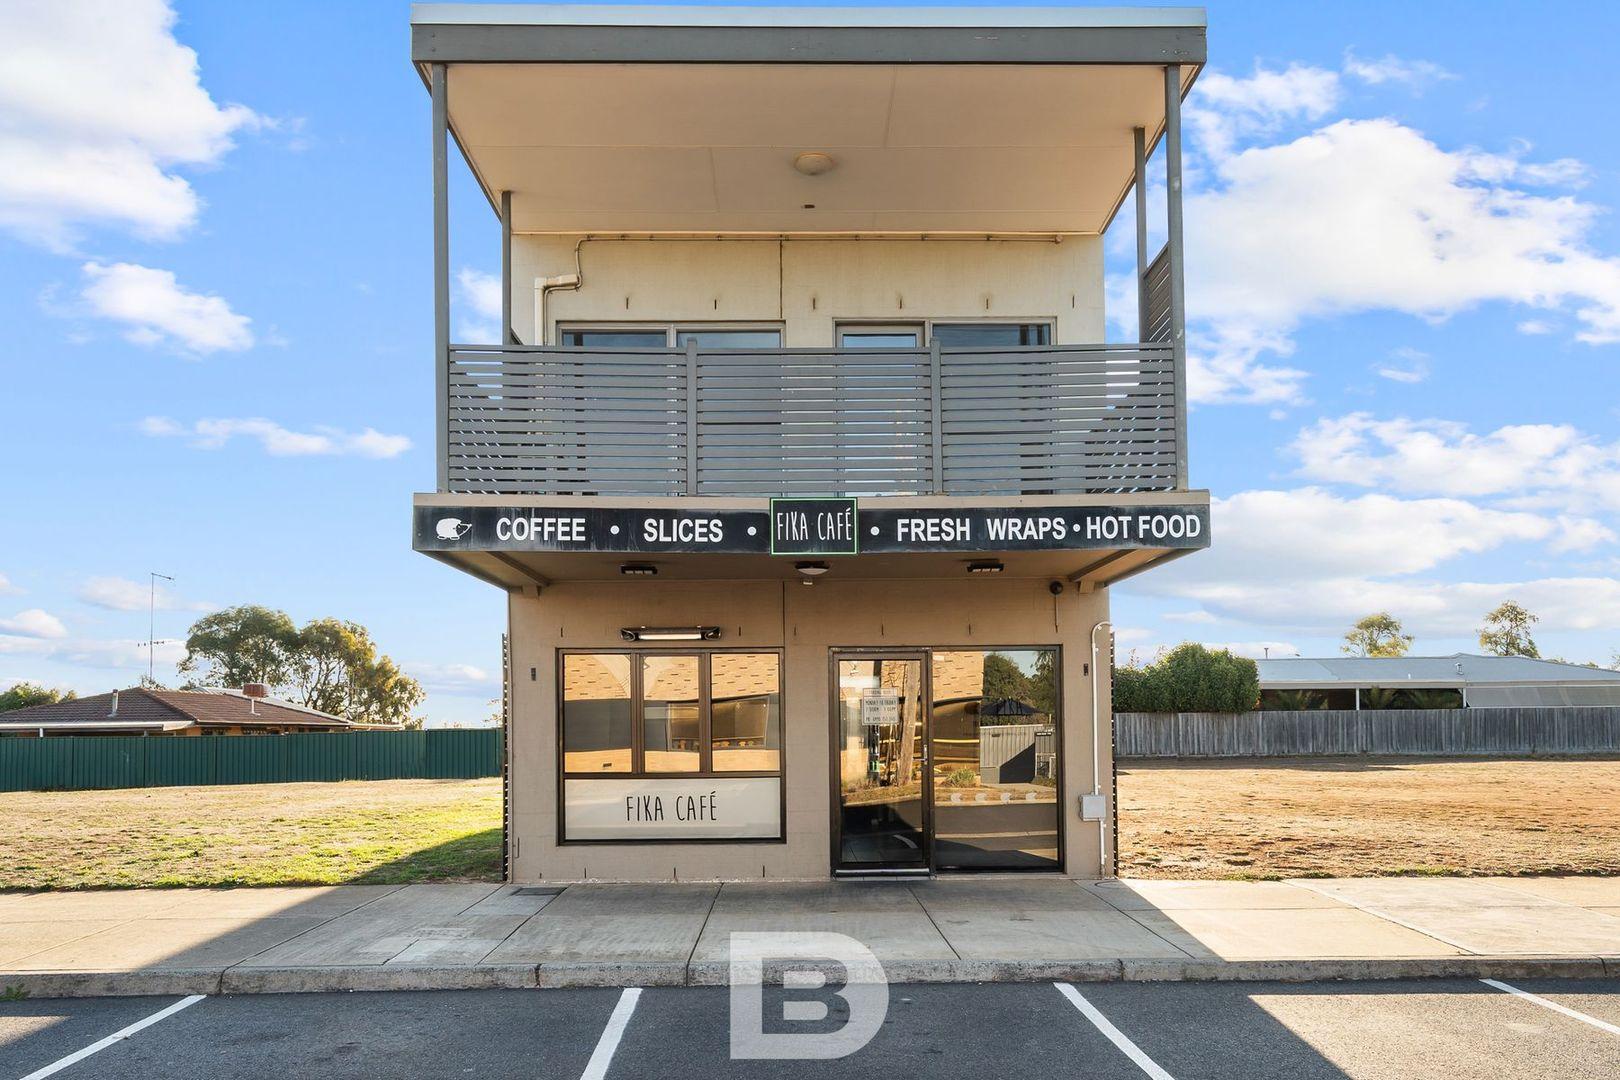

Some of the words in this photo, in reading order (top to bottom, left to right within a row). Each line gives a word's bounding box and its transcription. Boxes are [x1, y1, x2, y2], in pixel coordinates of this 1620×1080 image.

[497, 517, 586, 542] COFFEE
[643, 518, 723, 543] SLICES
[777, 511, 809, 541] FIKA
[817, 508, 854, 541] CAFÉ
[897, 517, 971, 542] FRESH
[986, 517, 1066, 542] WRAPS
[1086, 515, 1132, 540] HOT
[1138, 514, 1201, 539] FOOD
[626, 796, 664, 822] FIKA
[676, 791, 717, 822] CAFÉ
